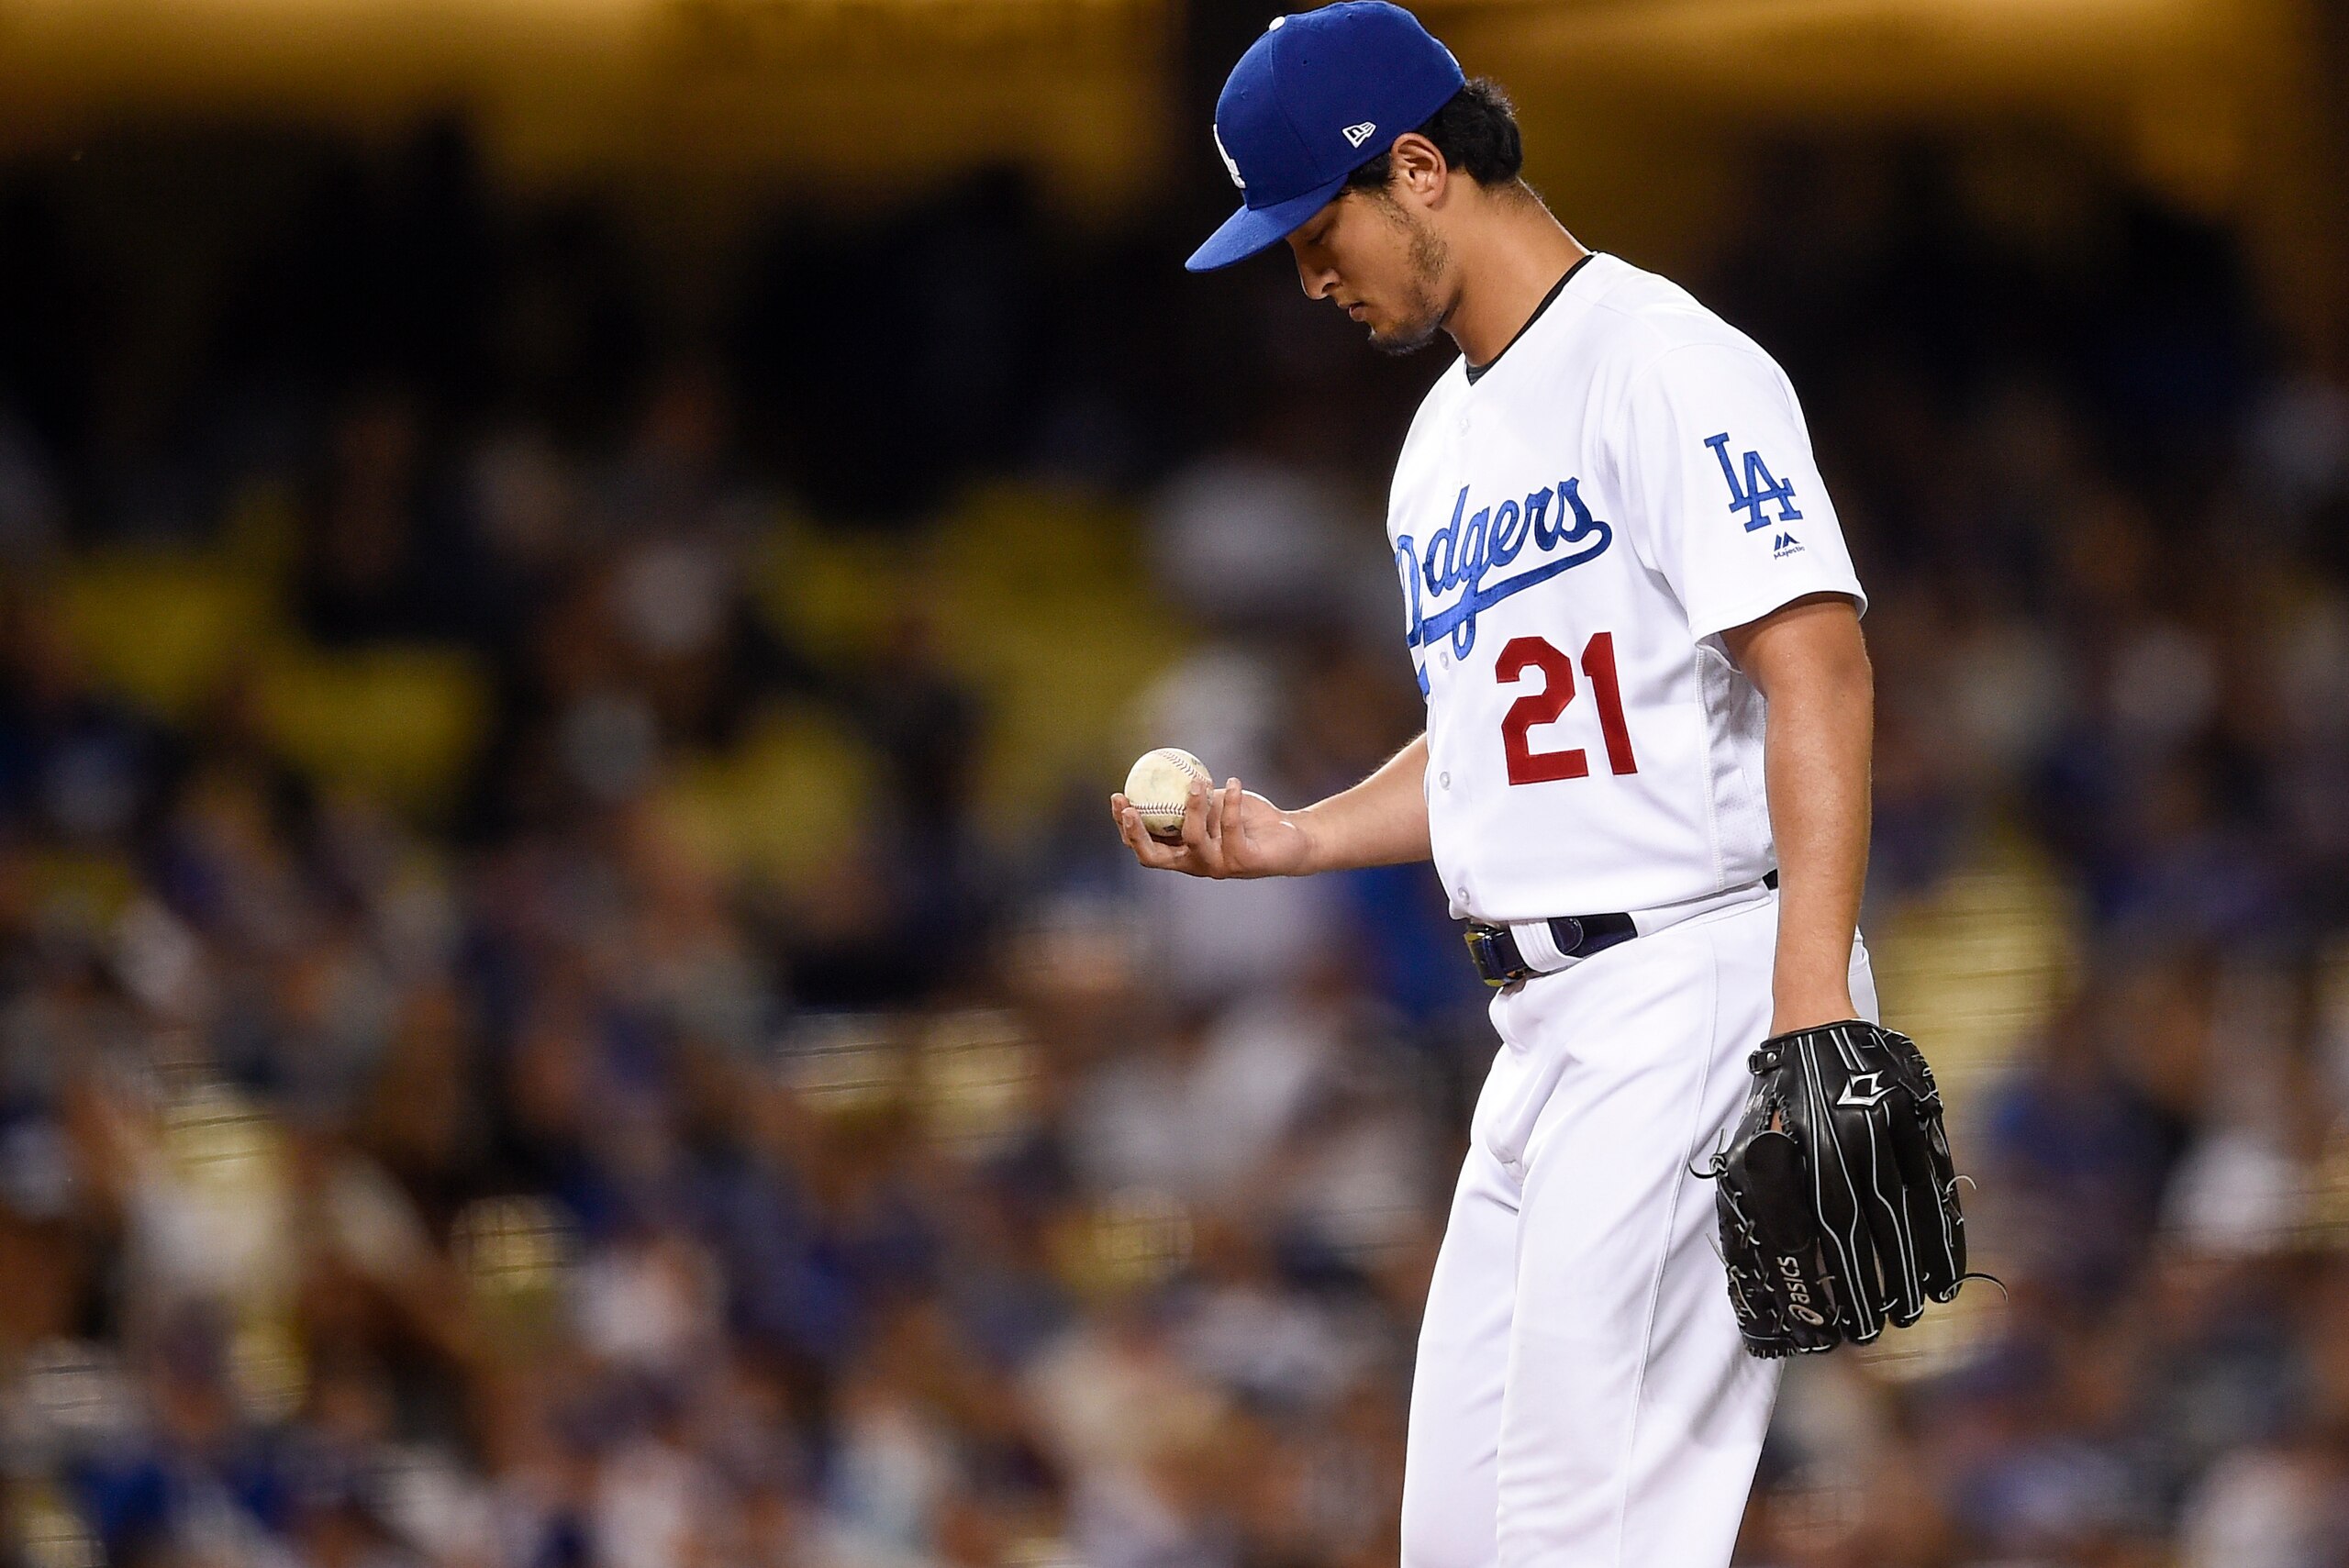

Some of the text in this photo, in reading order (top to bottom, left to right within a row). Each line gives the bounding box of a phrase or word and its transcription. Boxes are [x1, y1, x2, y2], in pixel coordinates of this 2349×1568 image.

[1704, 432, 1803, 533] LA
[1395, 477, 1613, 661] Ddgers
[1496, 632, 1638, 785] 21
